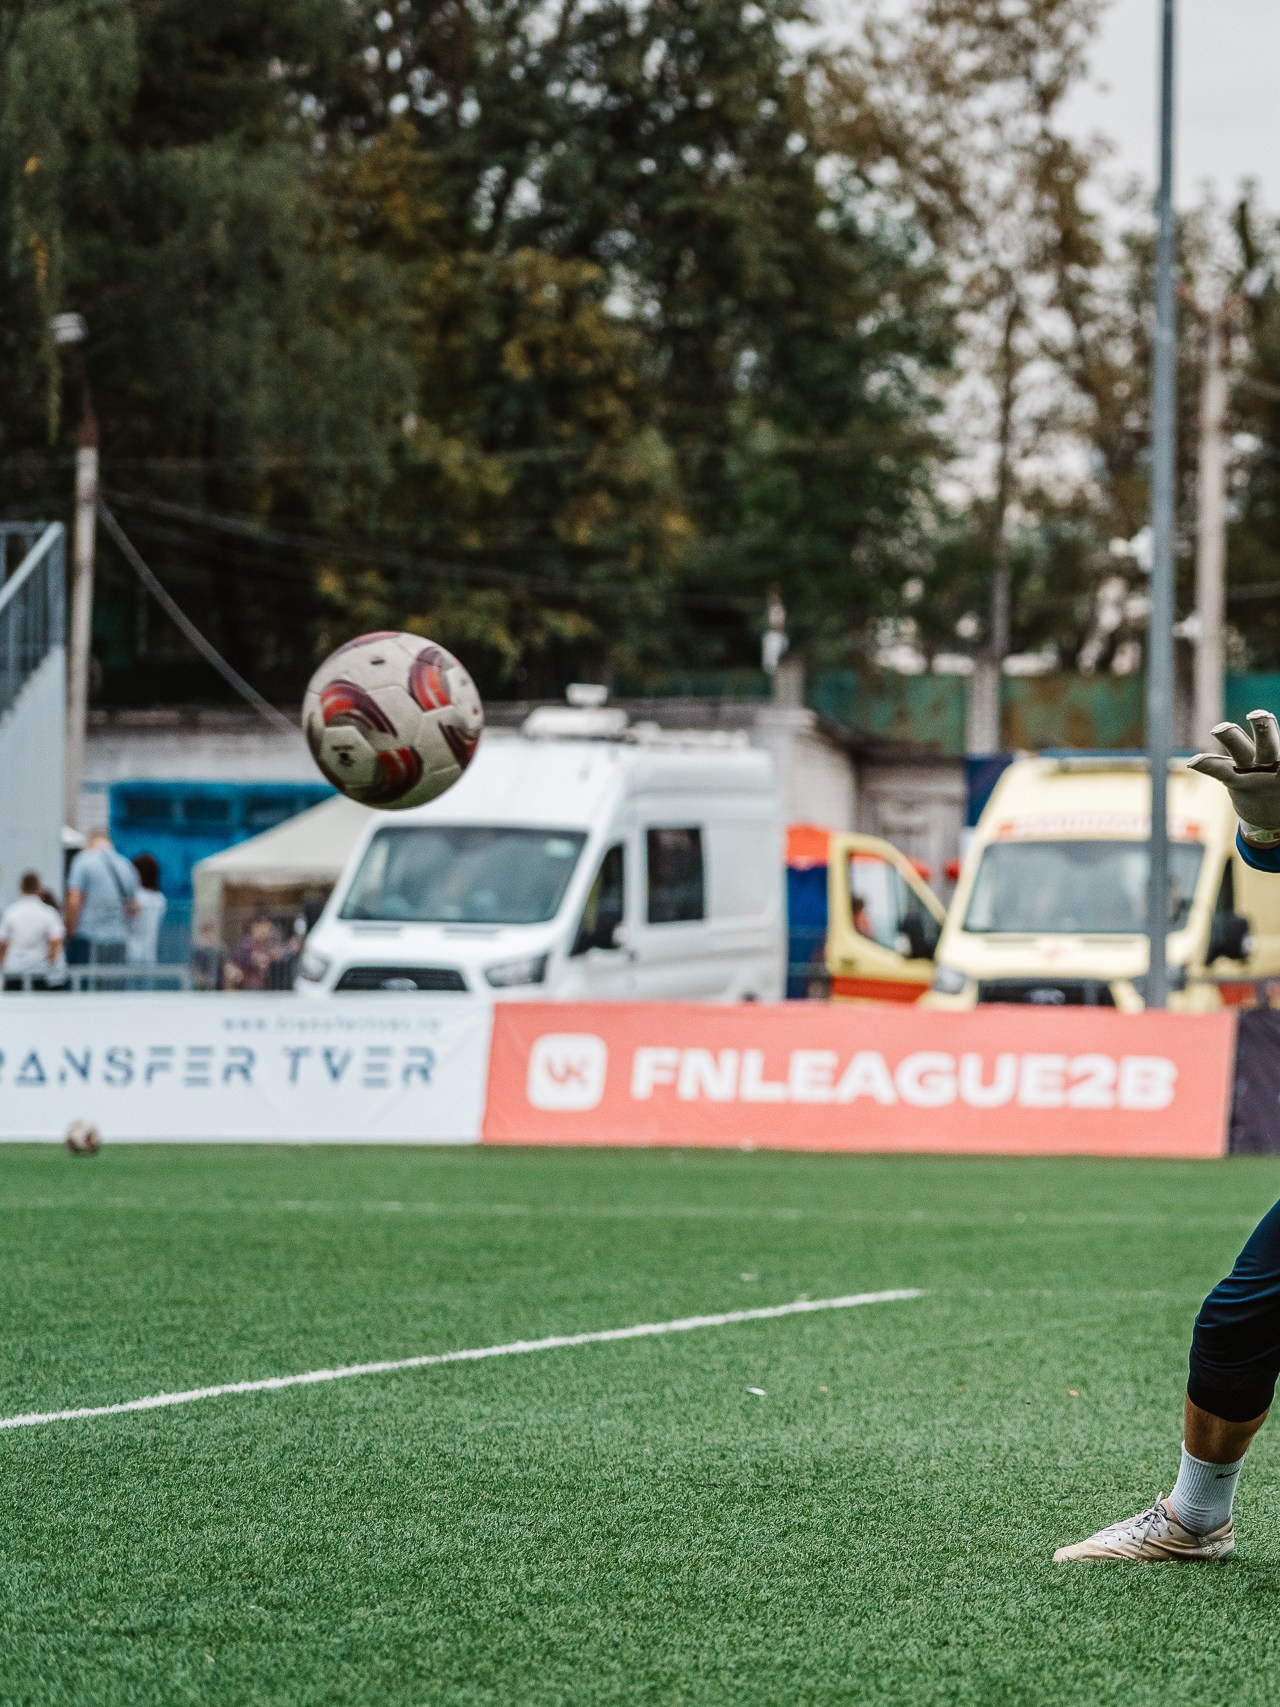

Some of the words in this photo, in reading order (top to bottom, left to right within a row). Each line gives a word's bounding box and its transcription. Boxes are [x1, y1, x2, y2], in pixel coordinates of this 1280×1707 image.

[0, 1046, 257, 1087] ANSFER
[283, 1046, 437, 1087] TVER
[630, 1046, 1178, 1111] FNLEAGUE2B
